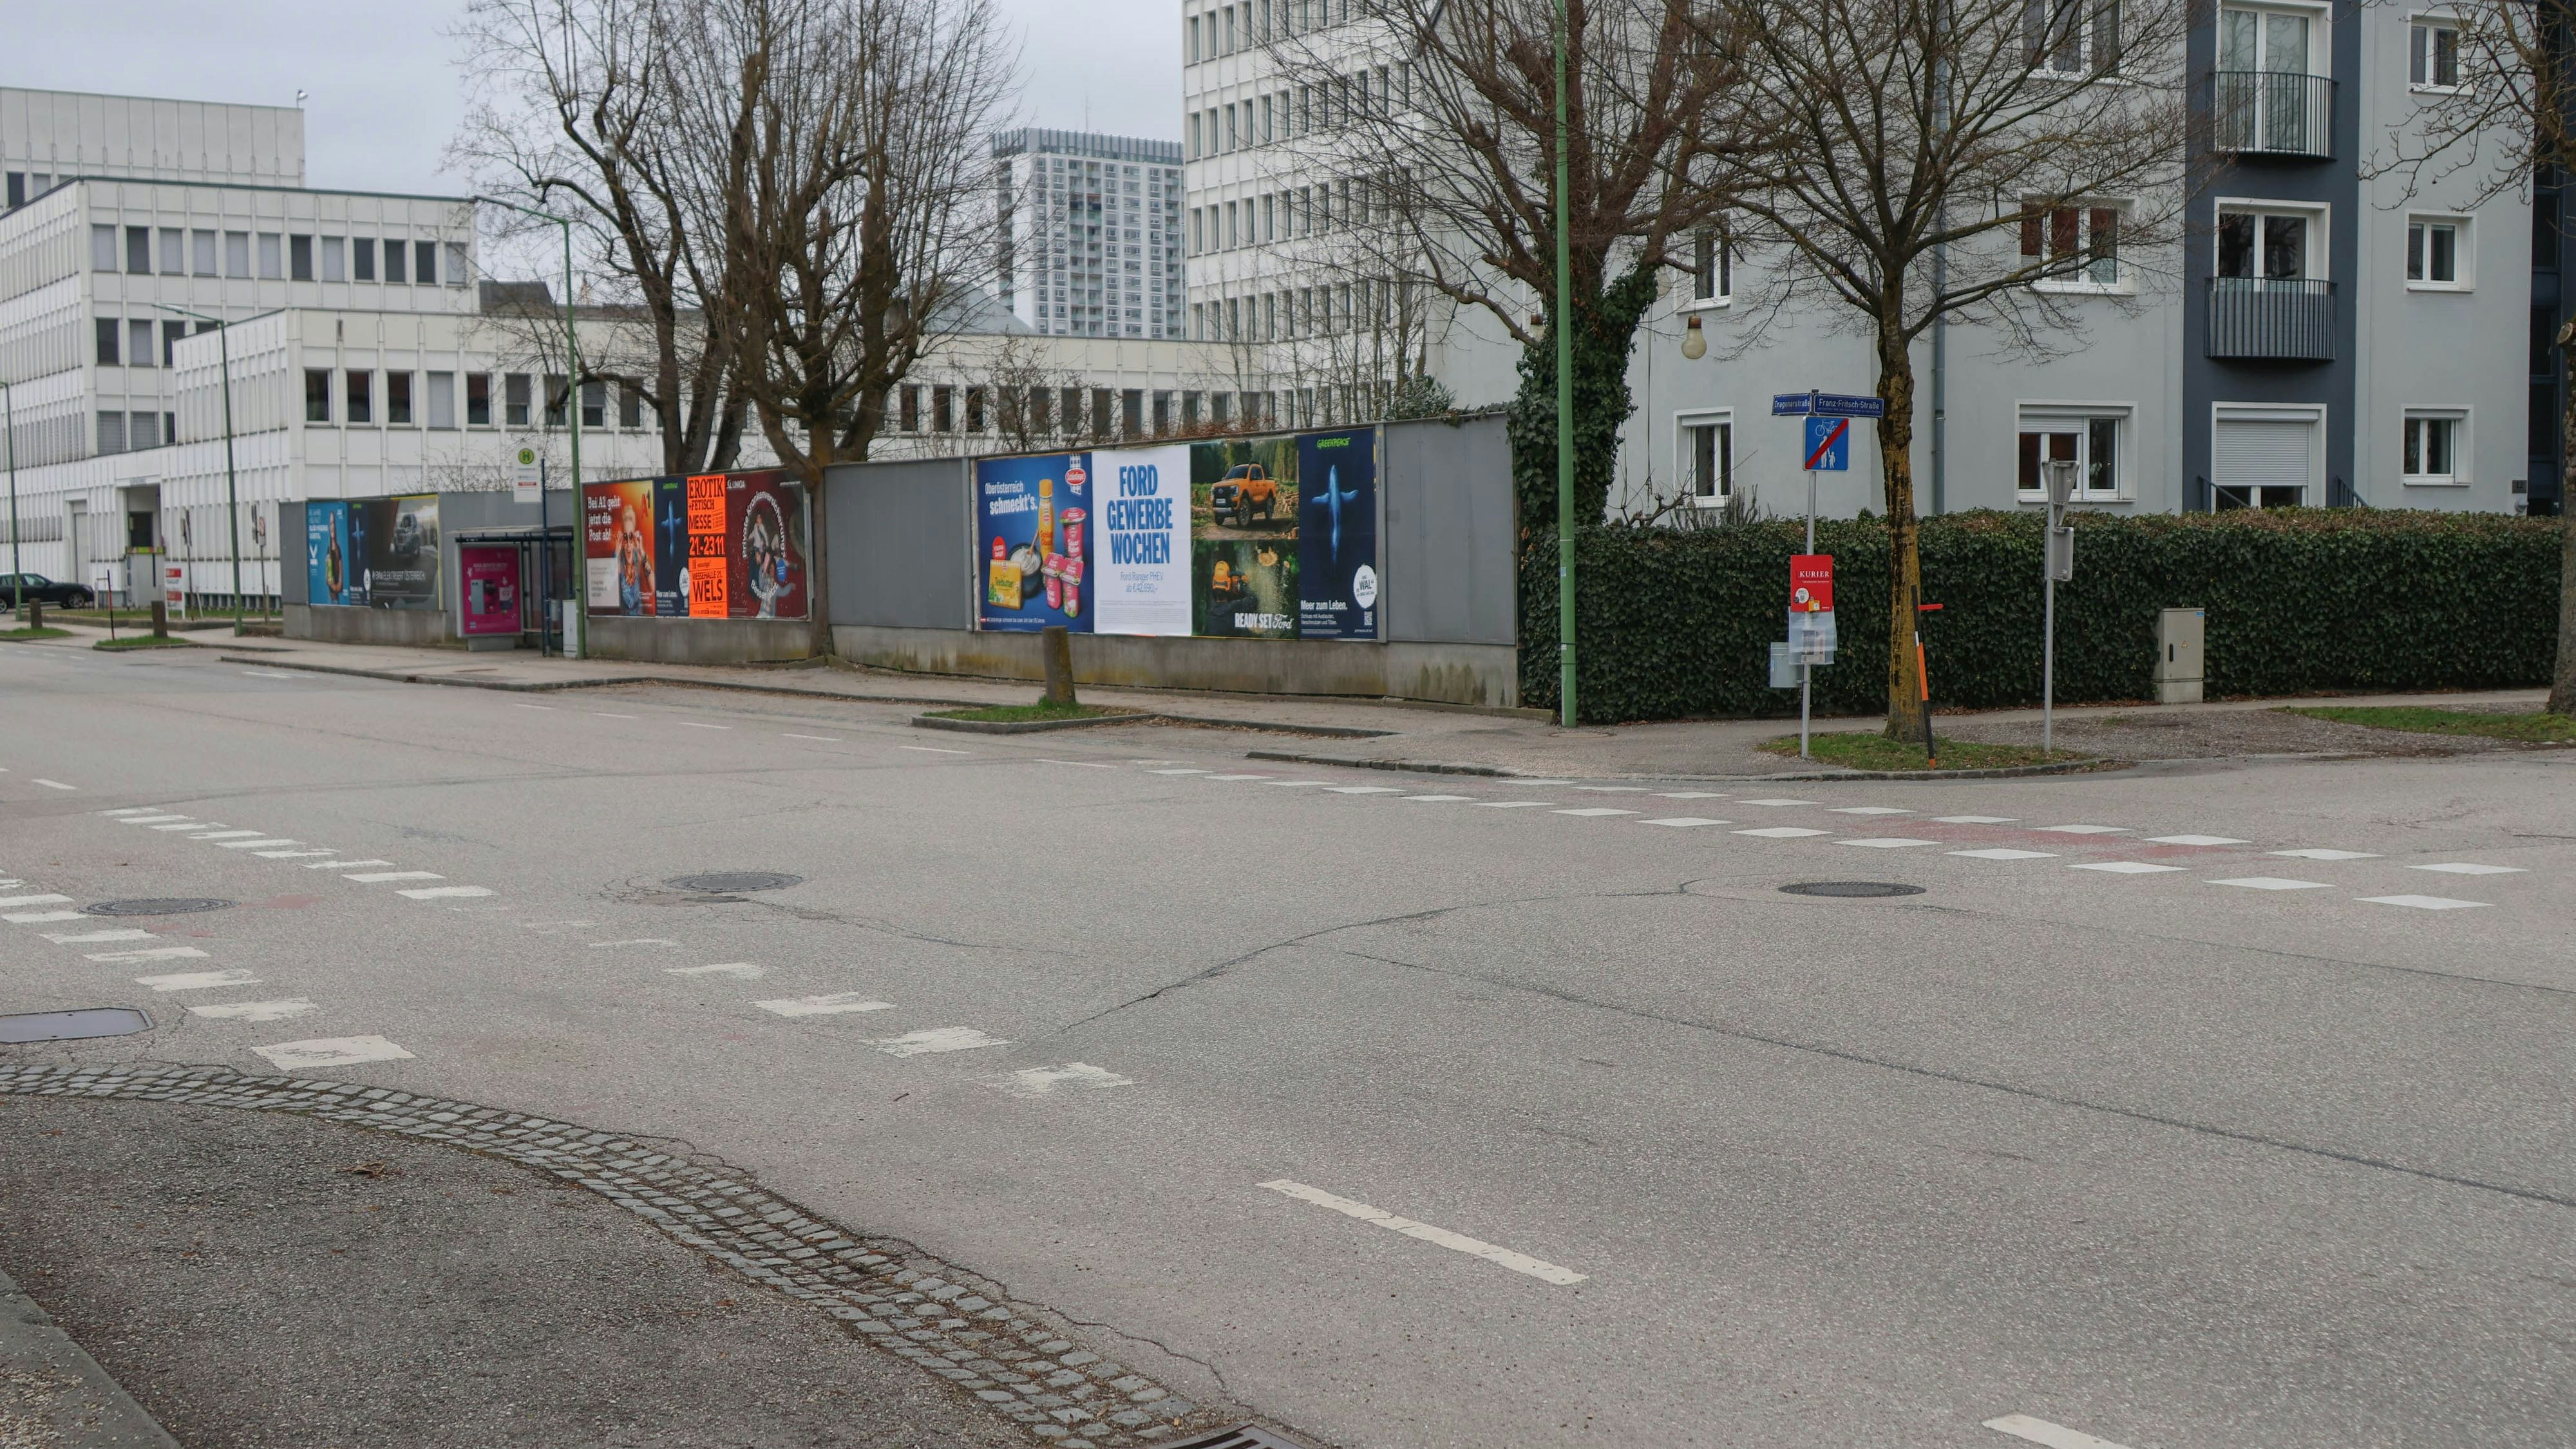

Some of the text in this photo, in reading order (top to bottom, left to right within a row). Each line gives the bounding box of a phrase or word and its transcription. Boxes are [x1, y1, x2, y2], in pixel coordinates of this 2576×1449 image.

[1774, 399, 1810, 409] Dragonerstraße
[1819, 398, 1880, 410] Franz-Fritsch-Straße
[1316, 437, 1350, 449] GREENPEACE
[985, 480, 1023, 495] Oberösterreich
[1119, 464, 1158, 497] FORD
[688, 478, 724, 499] EROTIK
[587, 495, 621, 510] Bei A1 geht
[588, 513, 611, 527] jetzt die
[689, 515, 712, 529] MESSE
[1106, 498, 1173, 531] GEWERBE
[589, 528, 611, 541] Post ab!
[1110, 532, 1170, 564] WOCHEN
[693, 579, 723, 602] WELS
[1301, 600, 1348, 610] Meer zum Leben.
[1235, 613, 1294, 629] READY SET Ford
